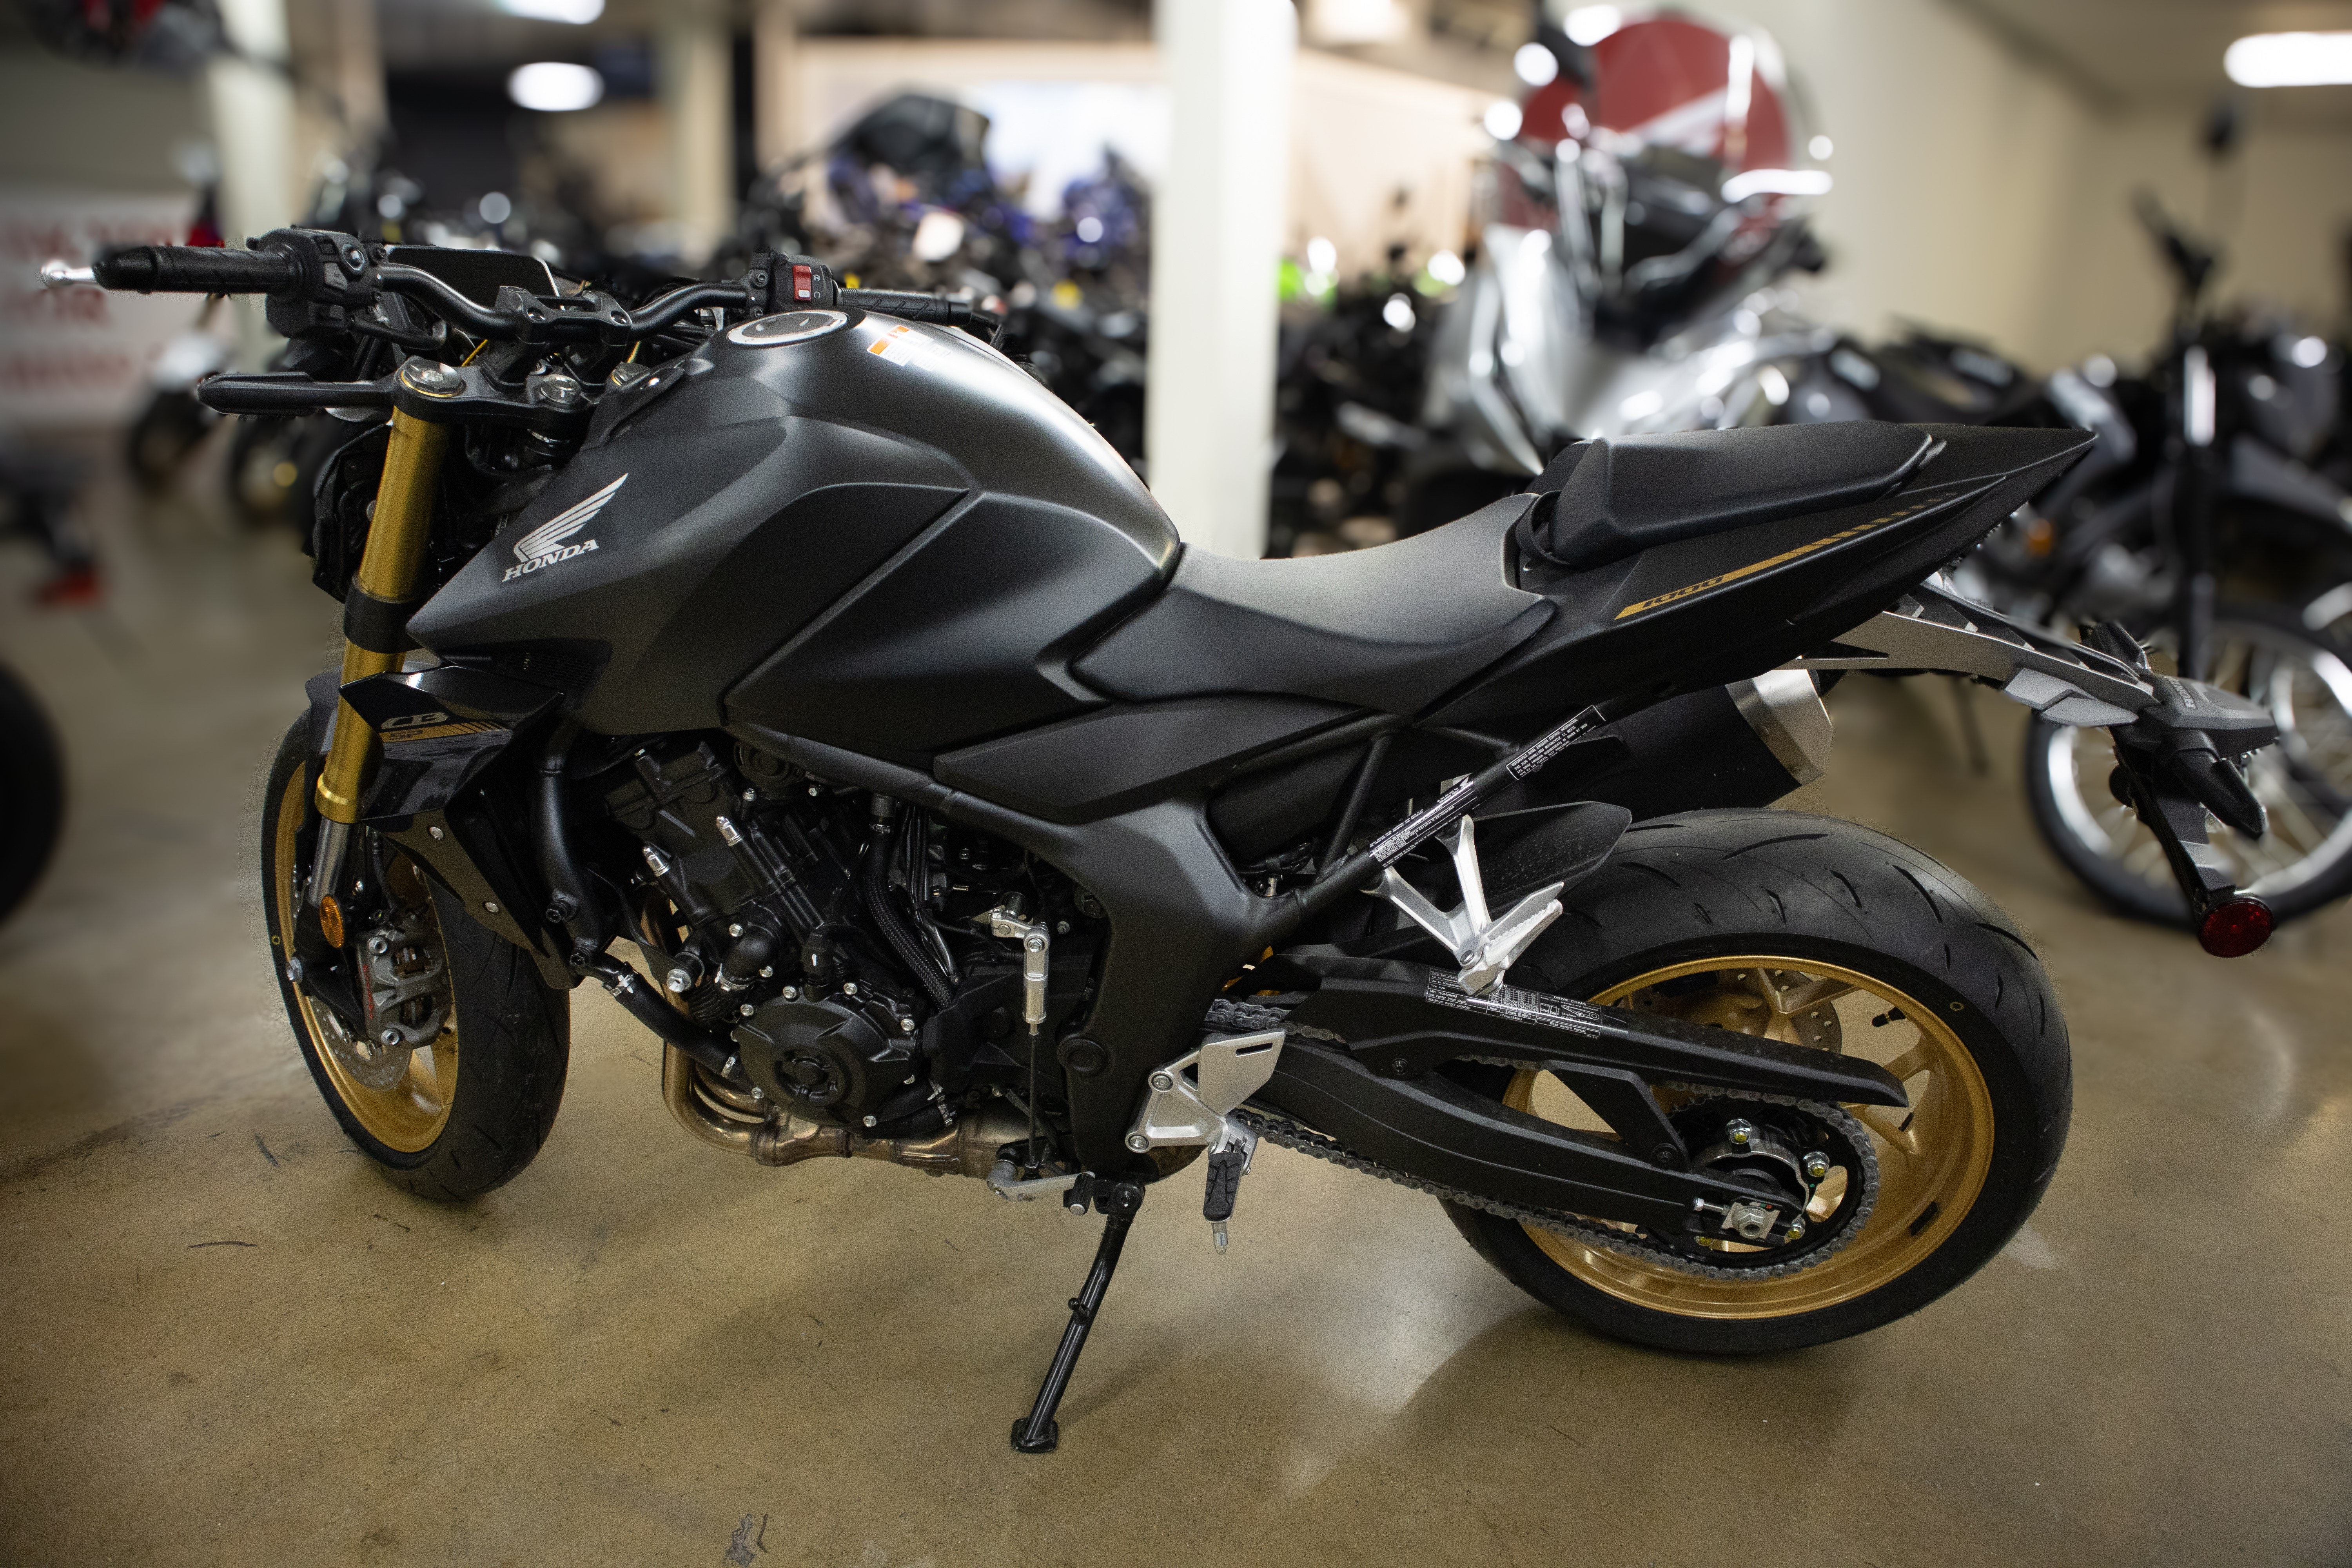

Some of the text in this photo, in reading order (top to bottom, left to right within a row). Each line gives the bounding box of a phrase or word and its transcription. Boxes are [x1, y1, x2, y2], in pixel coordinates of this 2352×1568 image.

[502, 539, 599, 582] HONDA
[1642, 575, 1724, 608] 1000
[381, 712, 449, 729] CB
[390, 730, 423, 740] SP
[1511, 753, 1528, 766] MOTORCYCLE
[1536, 739, 1548, 749] EMISSION
[1548, 730, 1560, 740] CONTROL
[1531, 754, 1543, 764] EMISSION
[1543, 741, 1562, 755] REQUIREMENTS
